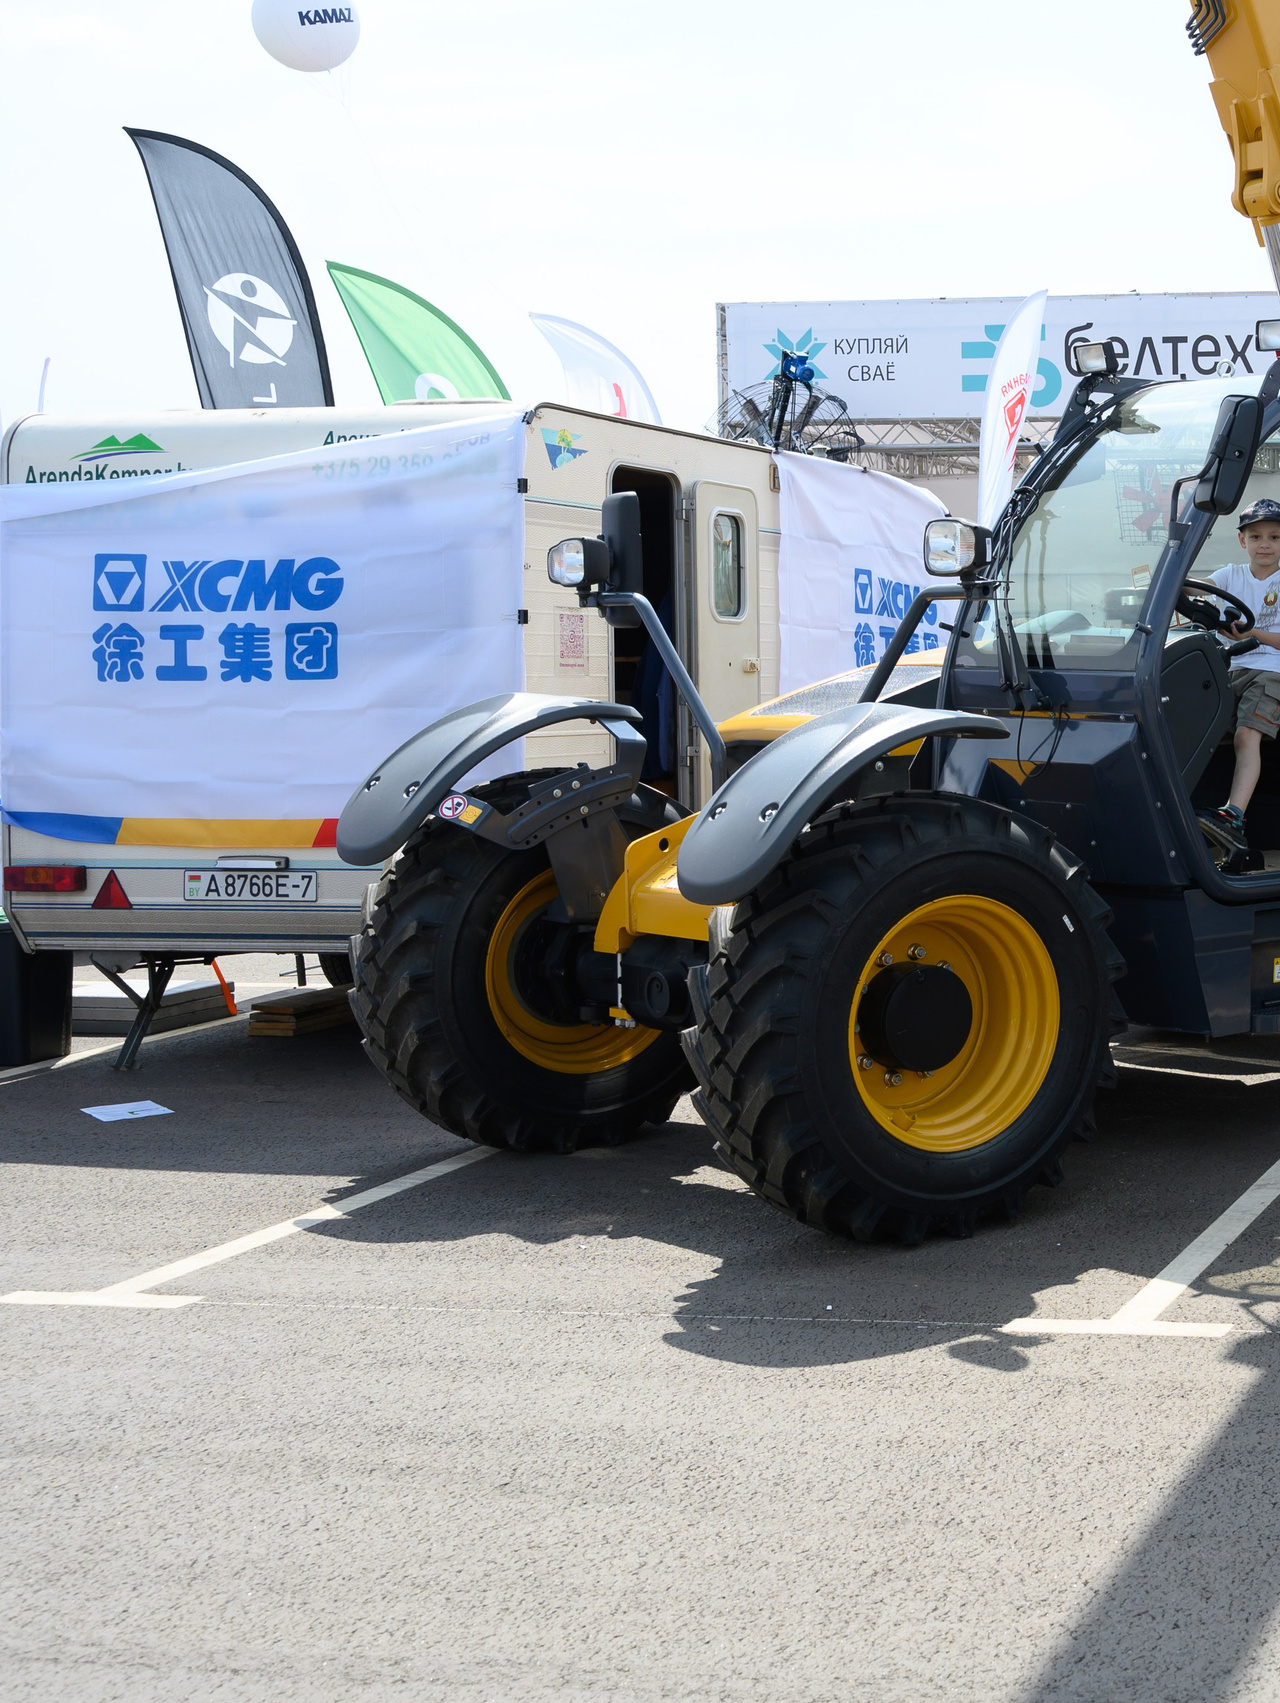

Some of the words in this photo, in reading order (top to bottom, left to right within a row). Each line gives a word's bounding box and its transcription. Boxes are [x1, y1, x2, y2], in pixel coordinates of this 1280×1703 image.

[298, 8, 354, 26] KAMAZ
[834, 334, 908, 356] КУПЛЯЙ
[1064, 322, 1255, 378] белтех
[847, 361, 896, 382] СВАЁ
[148, 556, 344, 612] XCMG
[92, 622, 339, 683] 徐工集团
[188, 887, 200, 897] BY
